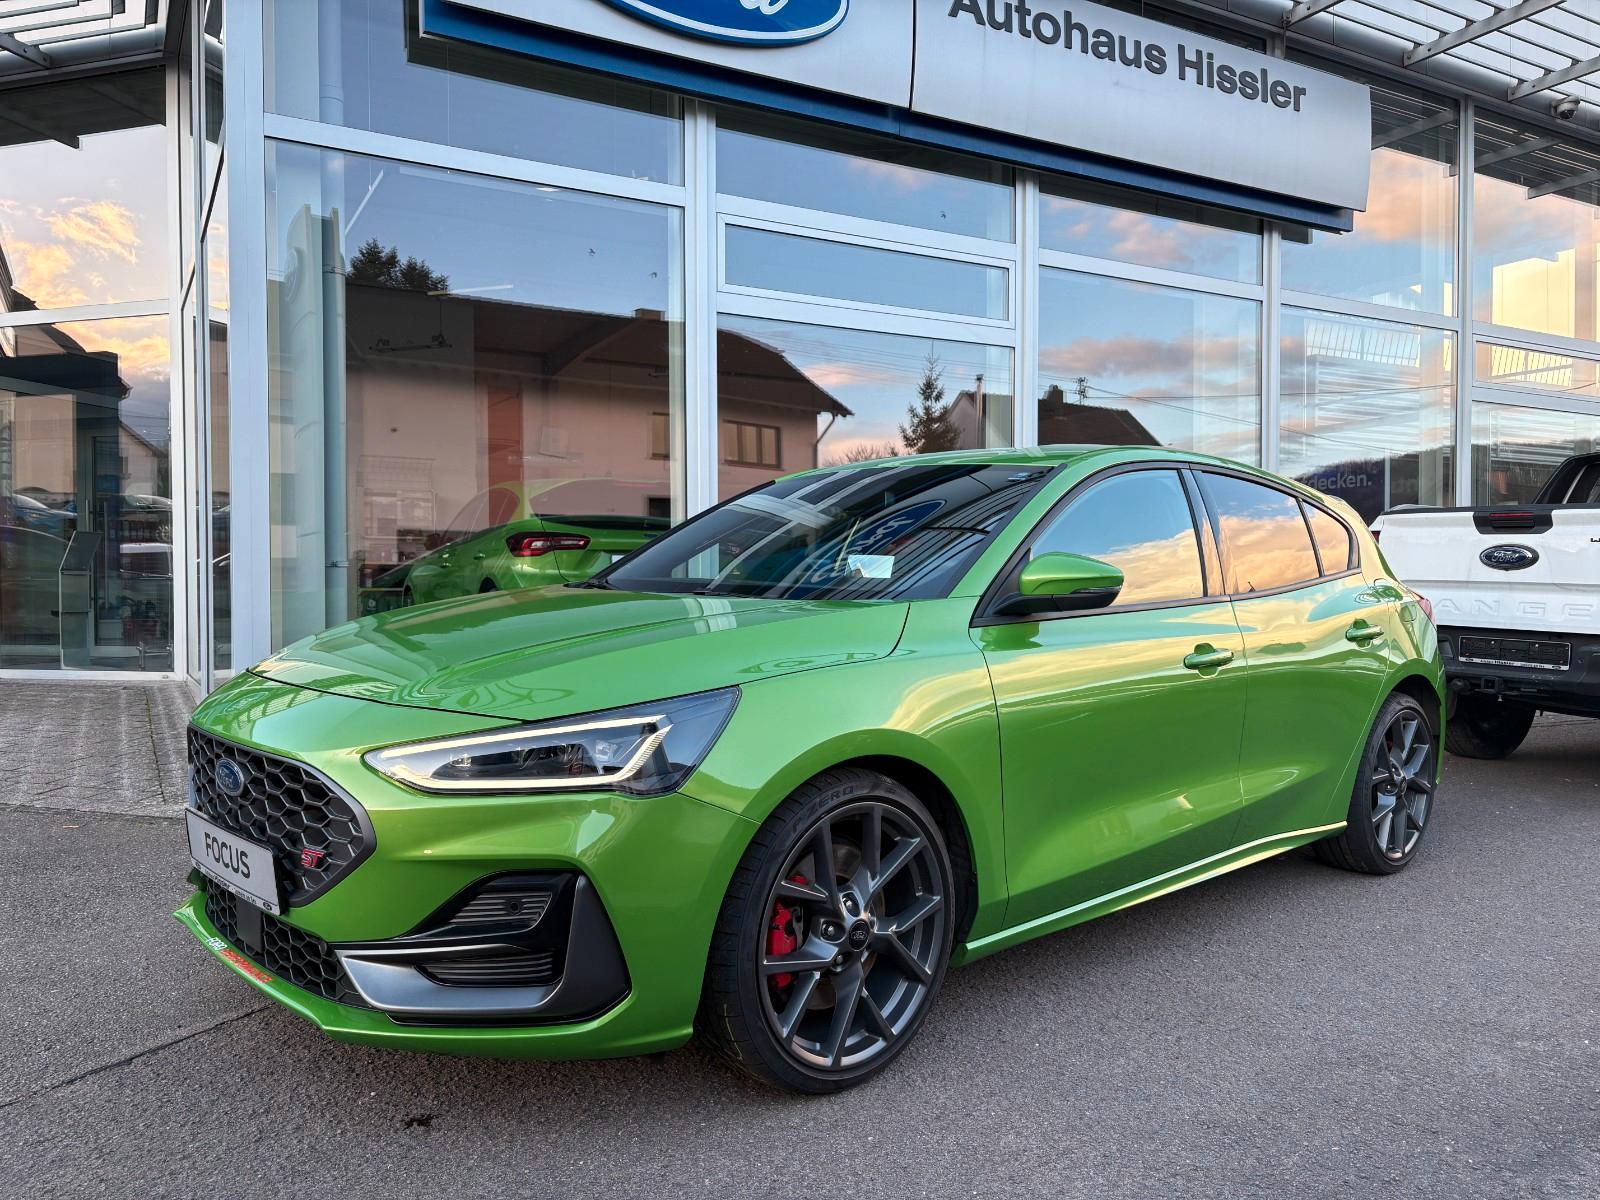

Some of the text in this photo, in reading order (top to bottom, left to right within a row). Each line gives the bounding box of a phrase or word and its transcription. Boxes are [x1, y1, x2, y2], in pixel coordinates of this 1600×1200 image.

[948, 0, 1307, 112] Autohaus Hissler
[204, 831, 251, 879] FOCUS
[301, 848, 325, 869] ST
